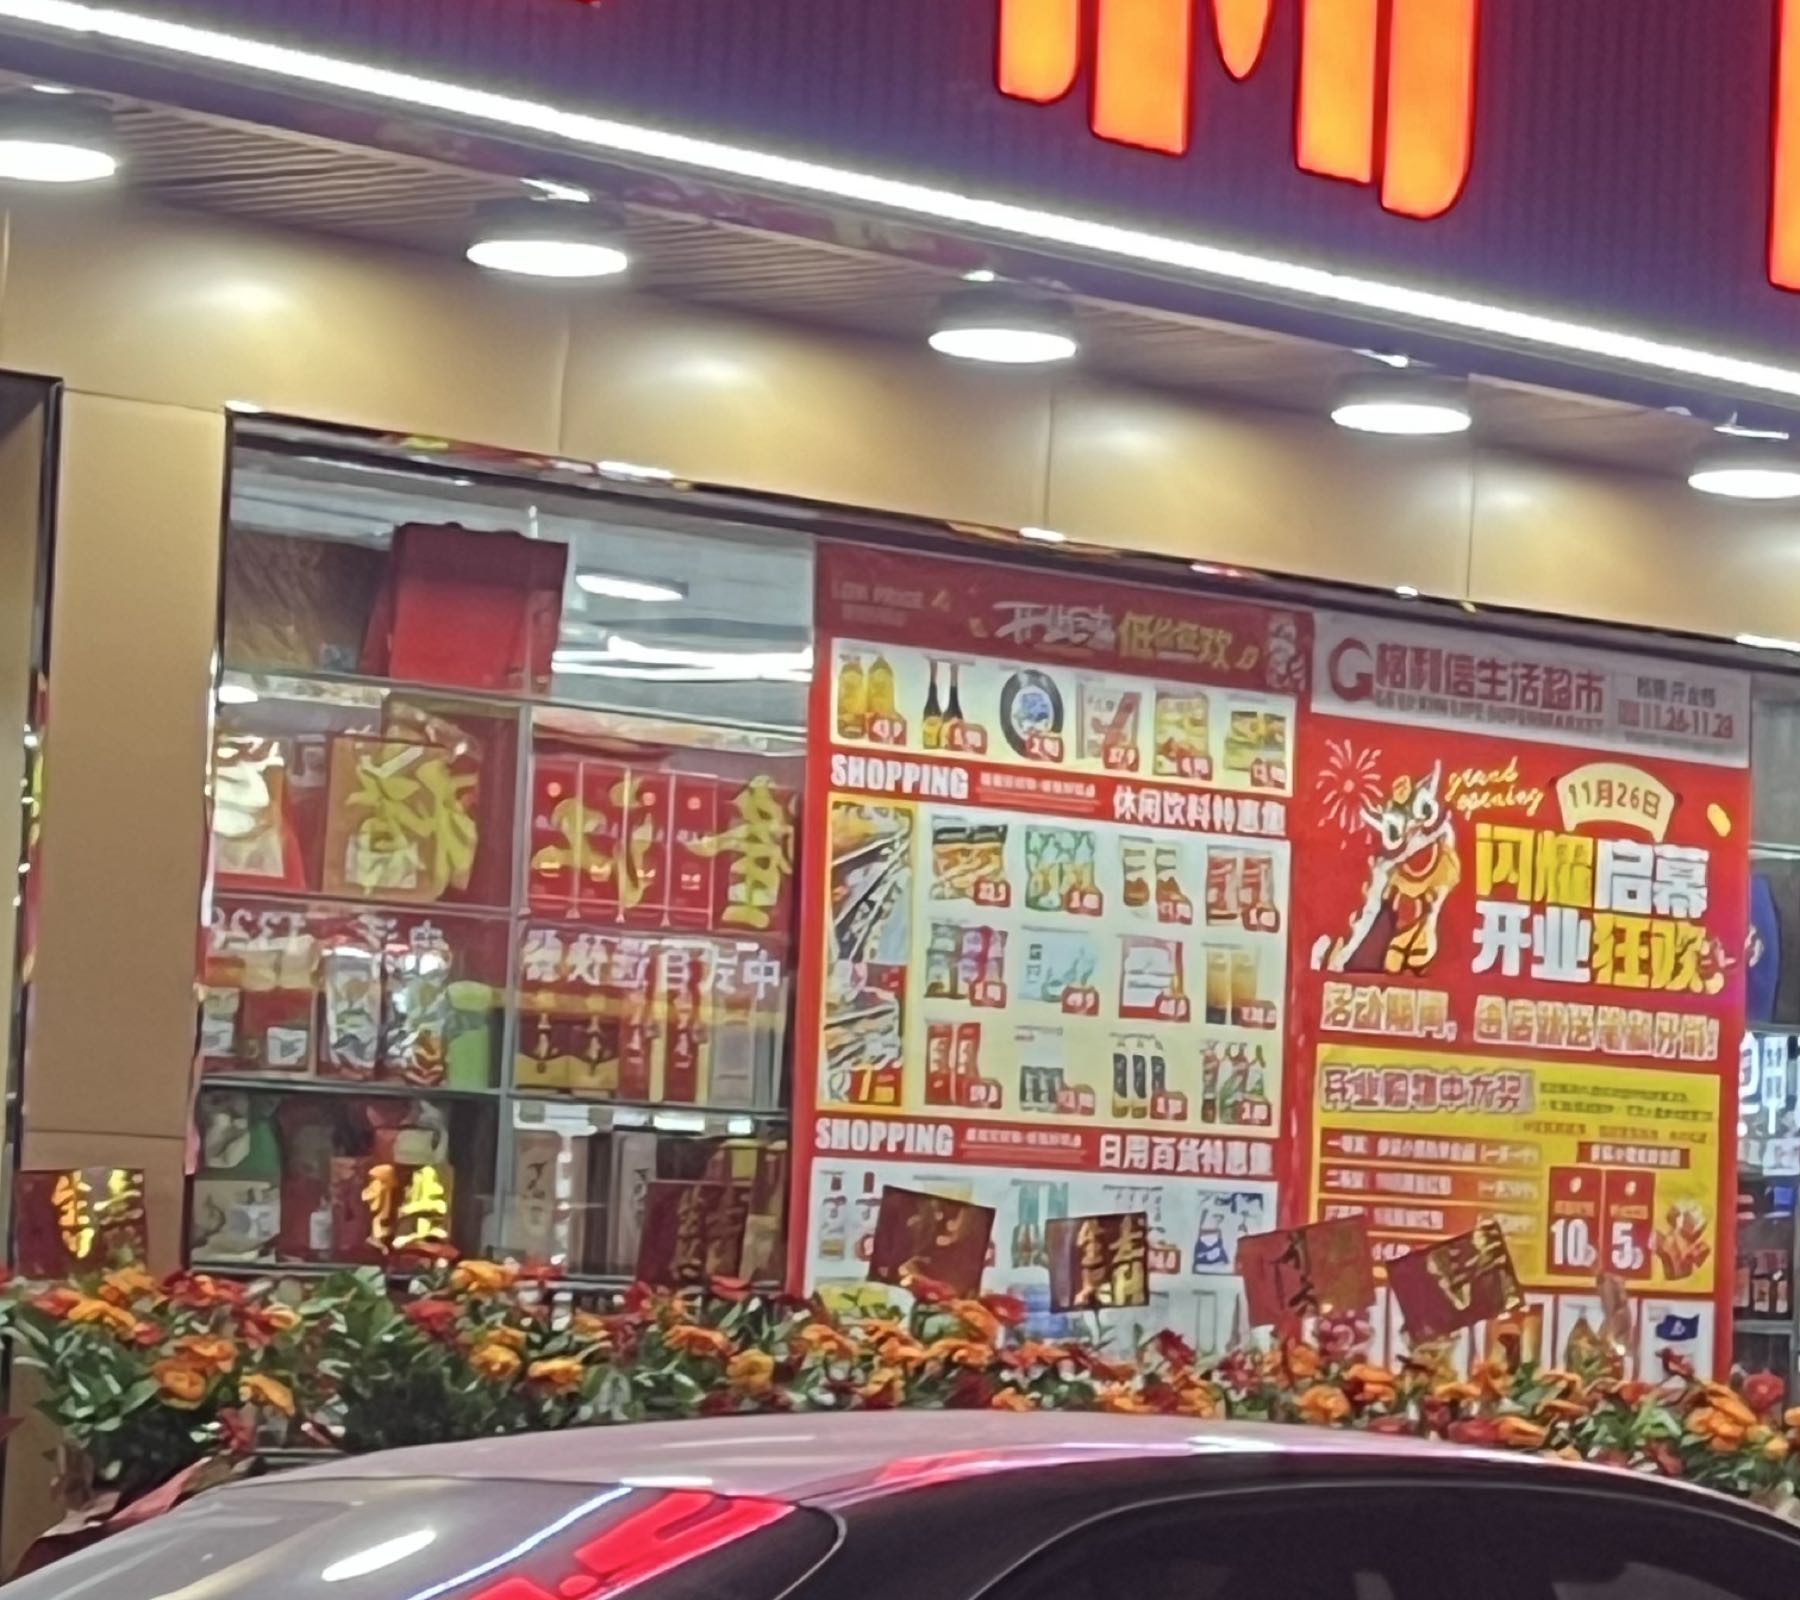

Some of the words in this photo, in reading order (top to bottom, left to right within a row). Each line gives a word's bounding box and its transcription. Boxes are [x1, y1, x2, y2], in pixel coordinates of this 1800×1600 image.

[1376, 642, 1605, 713] 格利信生活超市
[830, 754, 969, 799] SHOPPING
[1568, 777, 1661, 819] 11月26日
[1473, 900, 1720, 995] 开业狂欢
[815, 1118, 954, 1157] SHOPPING
